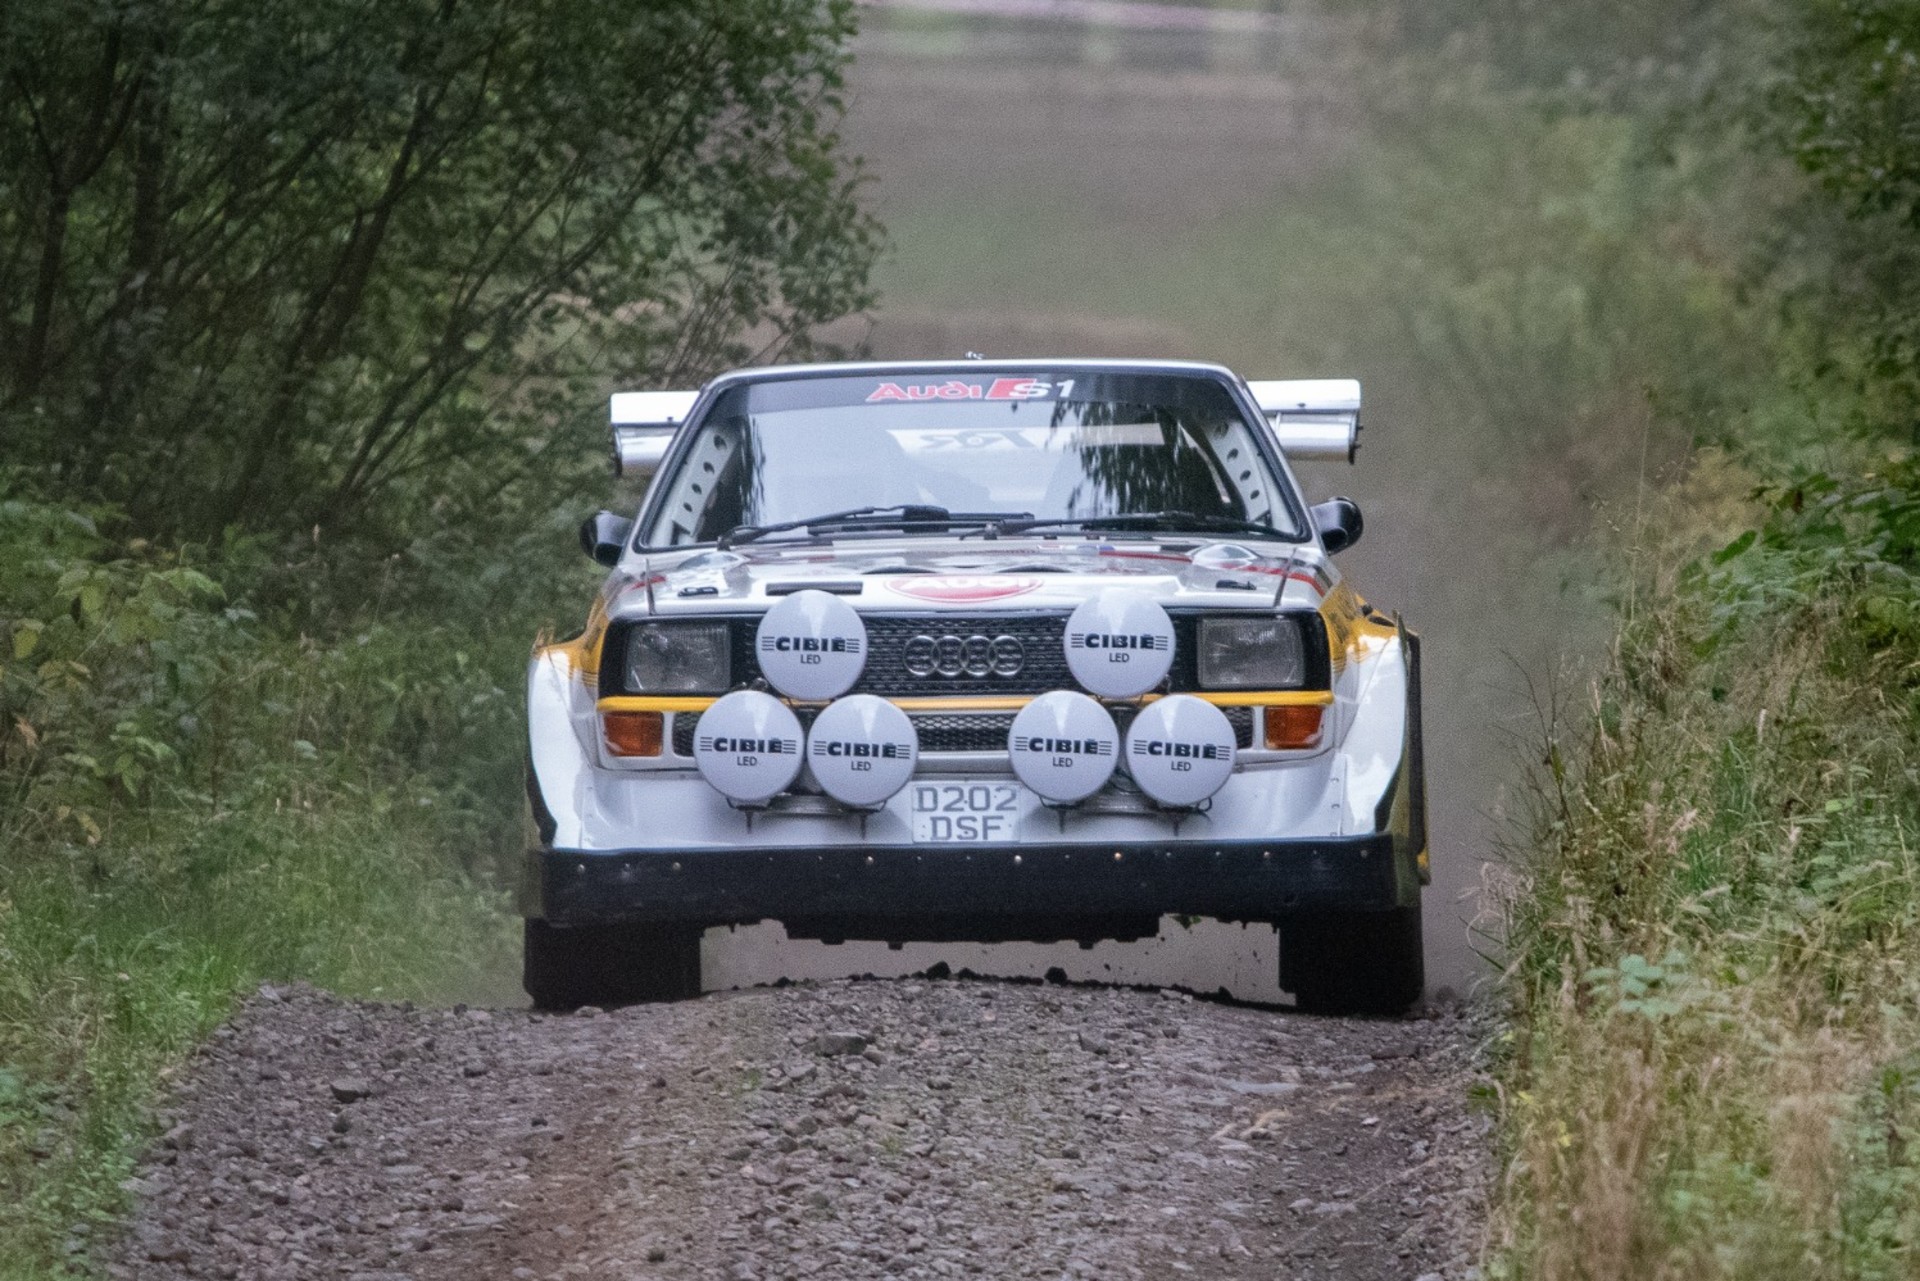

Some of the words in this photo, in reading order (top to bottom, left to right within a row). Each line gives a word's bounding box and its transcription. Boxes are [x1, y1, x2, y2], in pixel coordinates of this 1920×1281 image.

[865, 381, 982, 401] Audi
[1009, 379, 1076, 398] S1
[800, 654, 821, 664] LED
[1109, 653, 1130, 663] LED
[737, 756, 757, 766] LED
[851, 761, 871, 771] LED
[1052, 757, 1073, 767] LED
[1171, 761, 1192, 771] LED
[916, 786, 1017, 812] D202
[930, 815, 1004, 840] DSF
